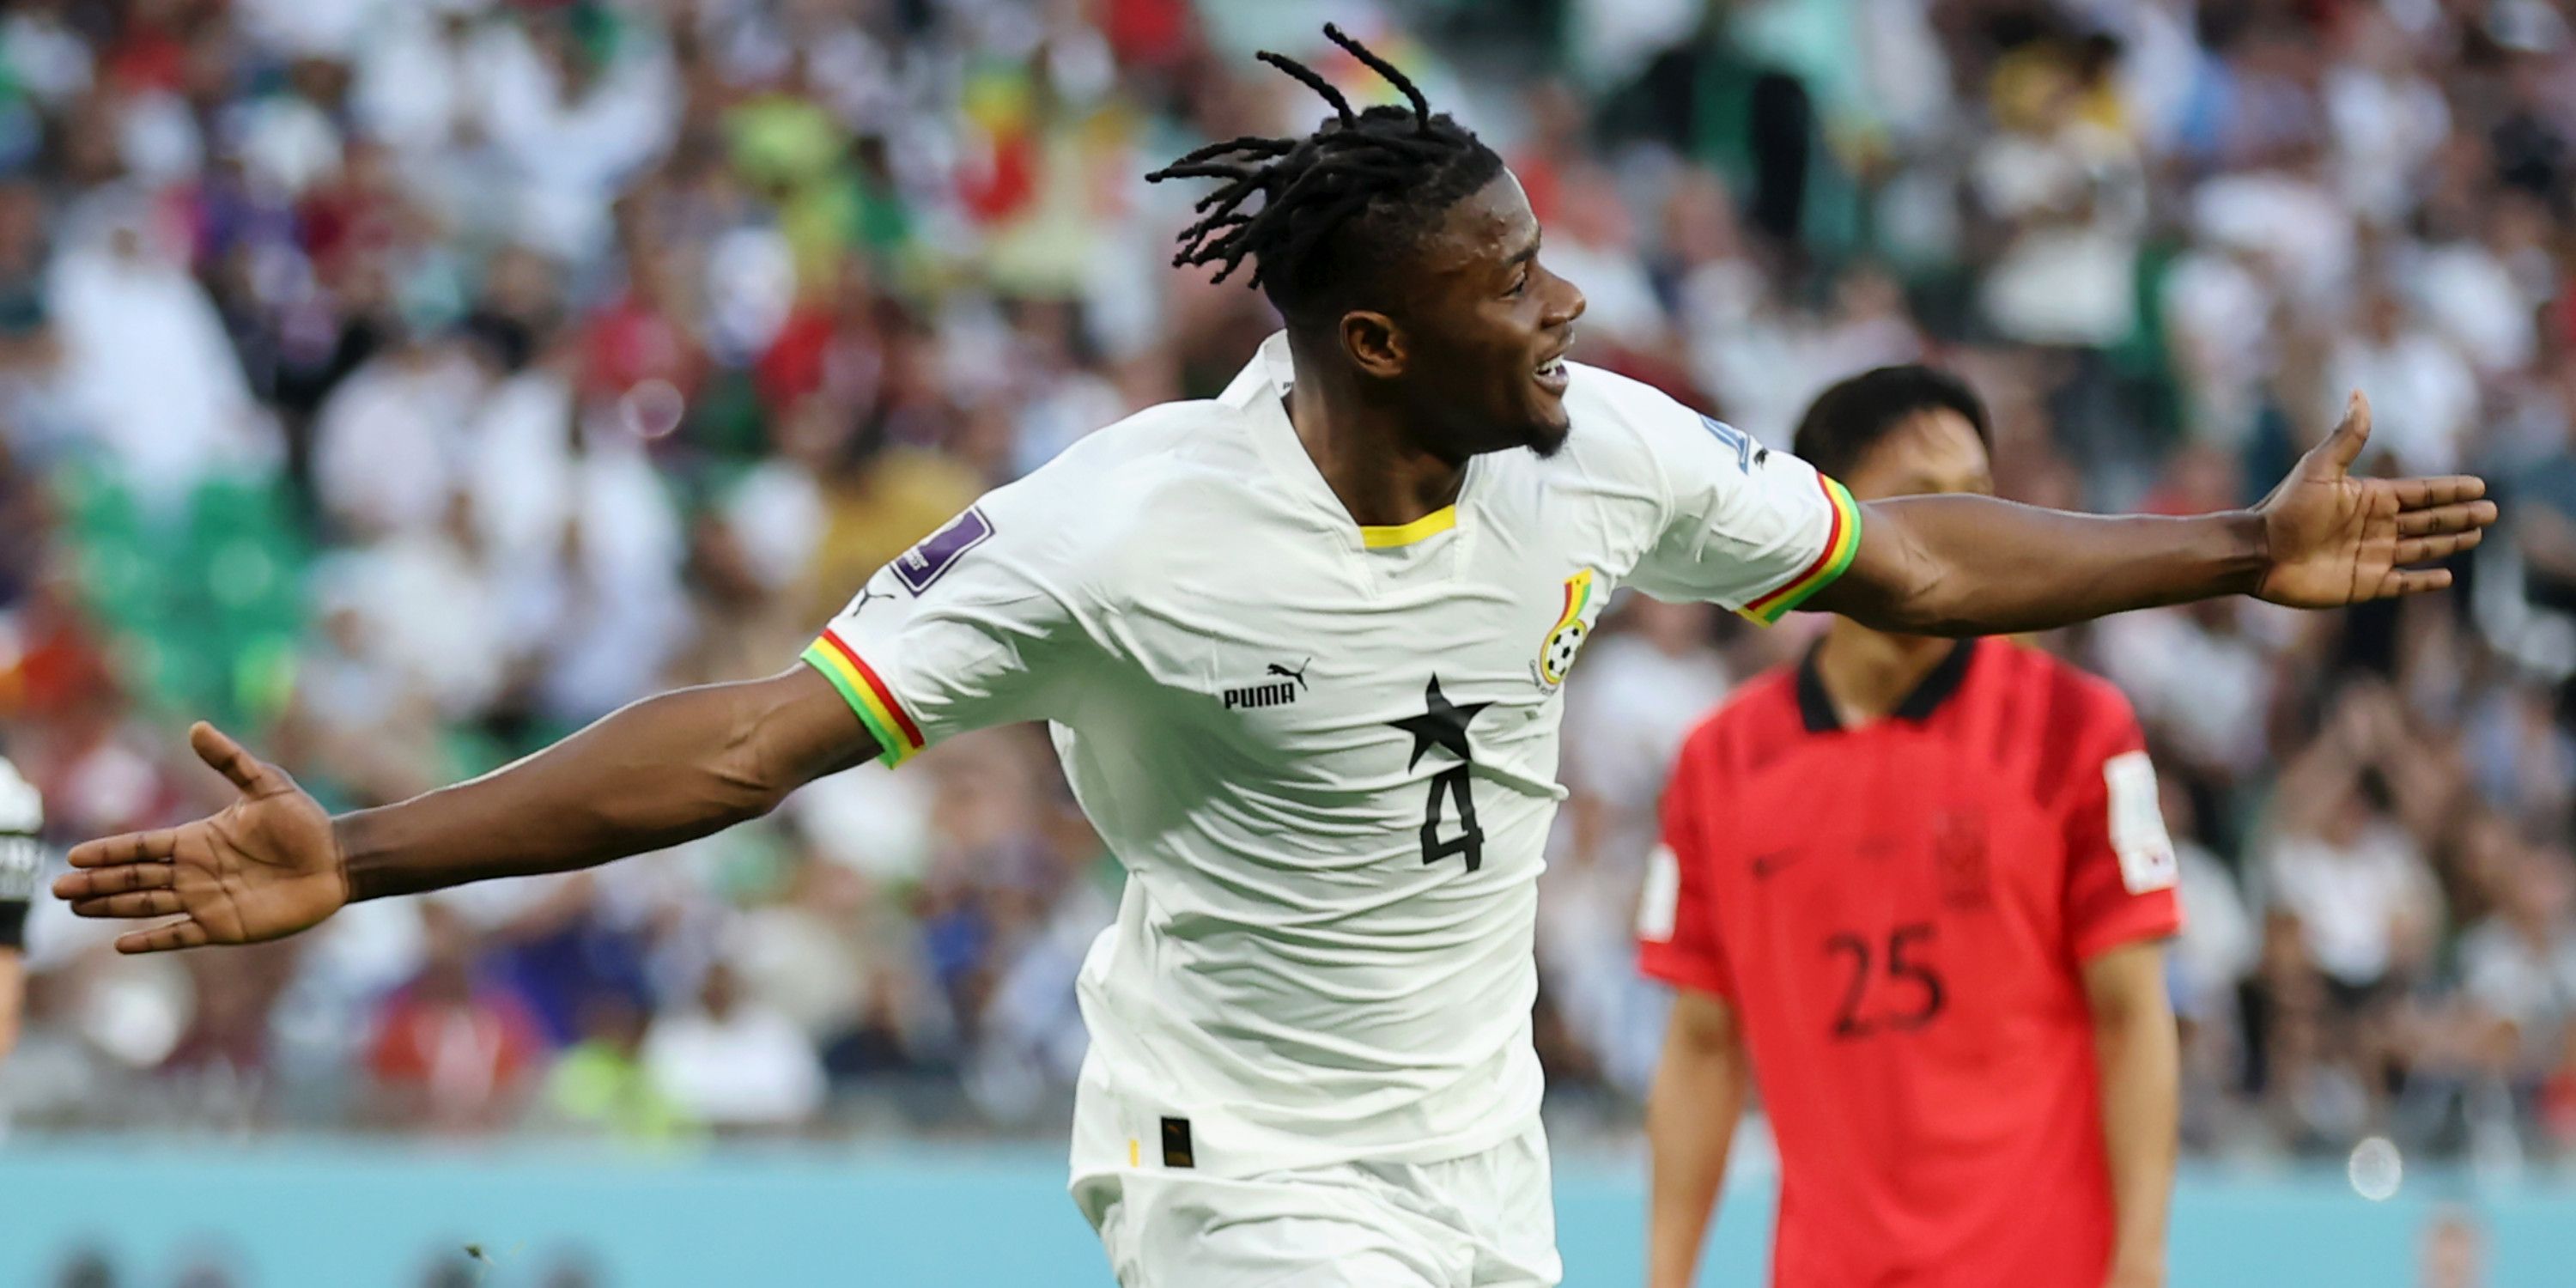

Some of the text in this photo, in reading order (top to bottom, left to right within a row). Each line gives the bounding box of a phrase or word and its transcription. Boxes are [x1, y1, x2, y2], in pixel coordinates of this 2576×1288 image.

[1224, 682, 1295, 709] PUMA
[1420, 762, 1485, 873] 4
[1823, 922, 1948, 1042] 25
